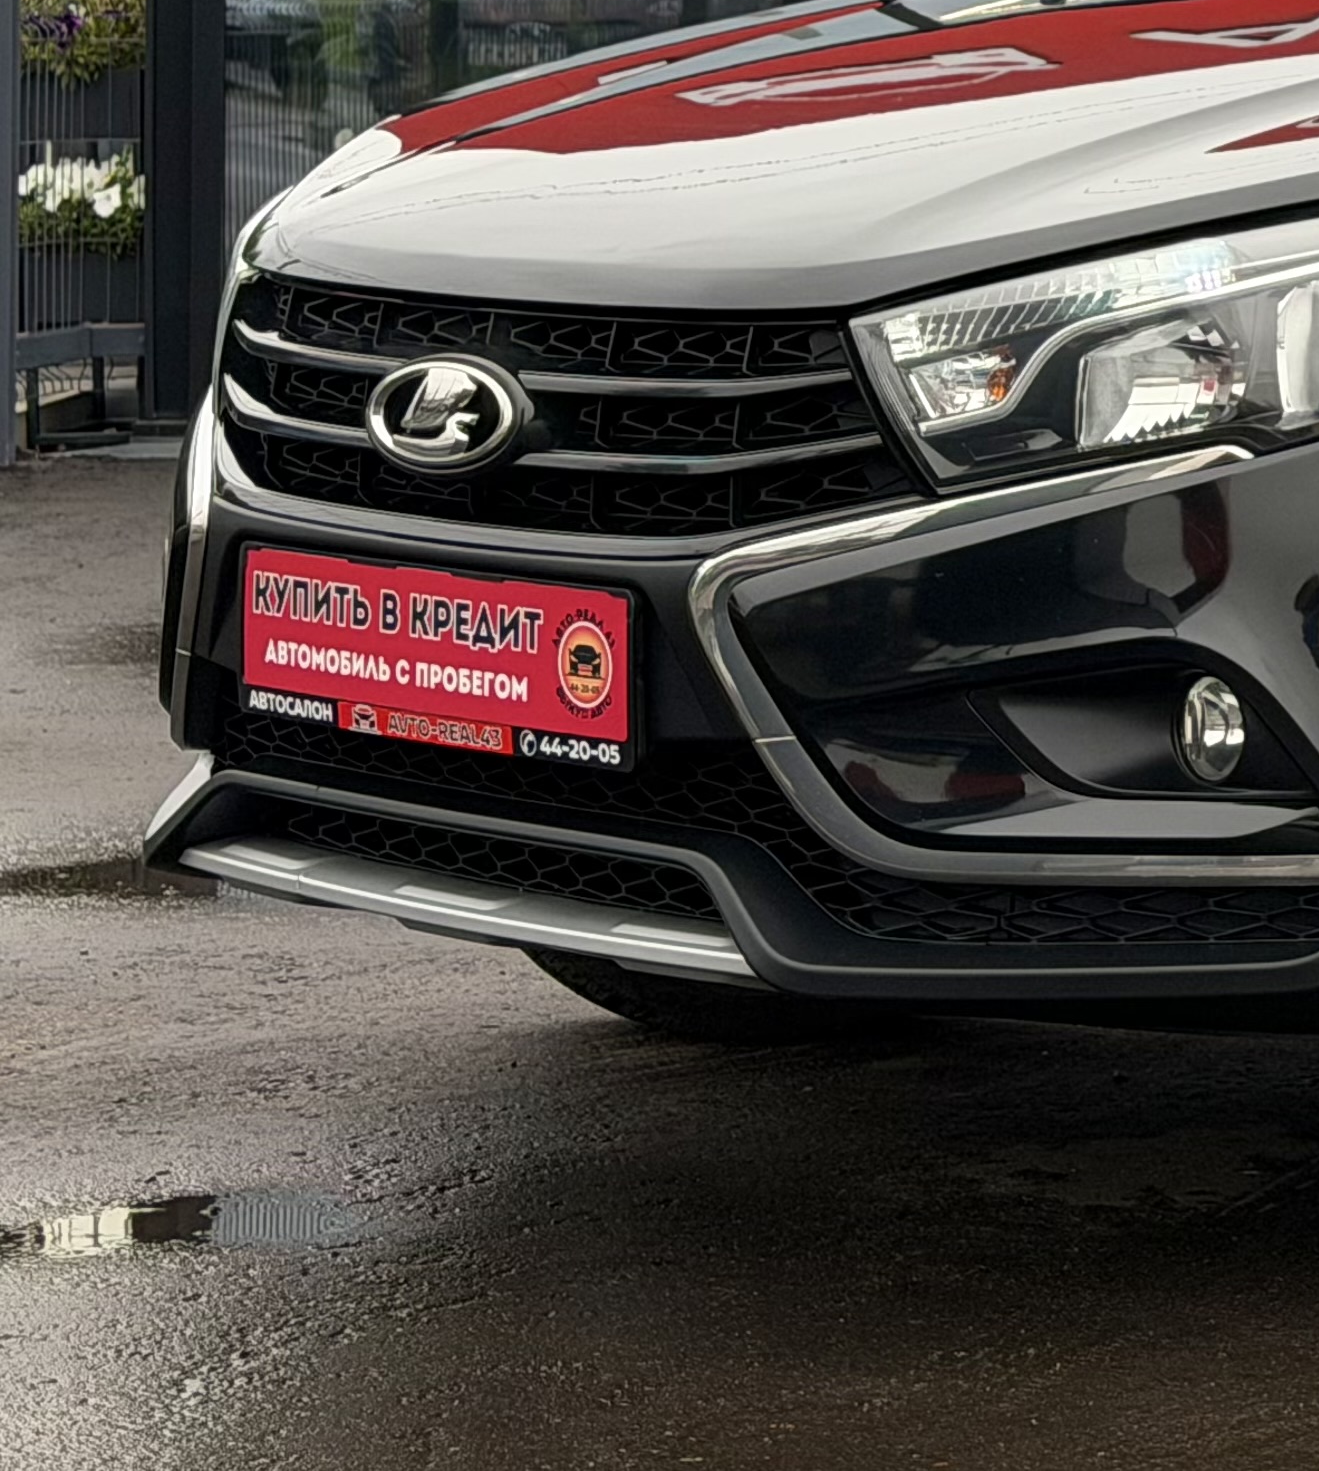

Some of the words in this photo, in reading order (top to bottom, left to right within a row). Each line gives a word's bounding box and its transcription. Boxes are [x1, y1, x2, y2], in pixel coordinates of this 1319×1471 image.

[253, 570, 372, 630] КУПИТЬ
[379, 589, 401, 635] В
[409, 592, 543, 655] КРЕДИТ
[264, 637, 391, 682] АВТОМОБИЛЬ
[395, 658, 411, 685] С
[415, 661, 528, 702] ПРОБЕГОМ
[249, 689, 333, 723] АВТОСАЛОН
[387, 711, 503, 749] AVTO-REAL43
[540, 735, 621, 765] 44-20-05
